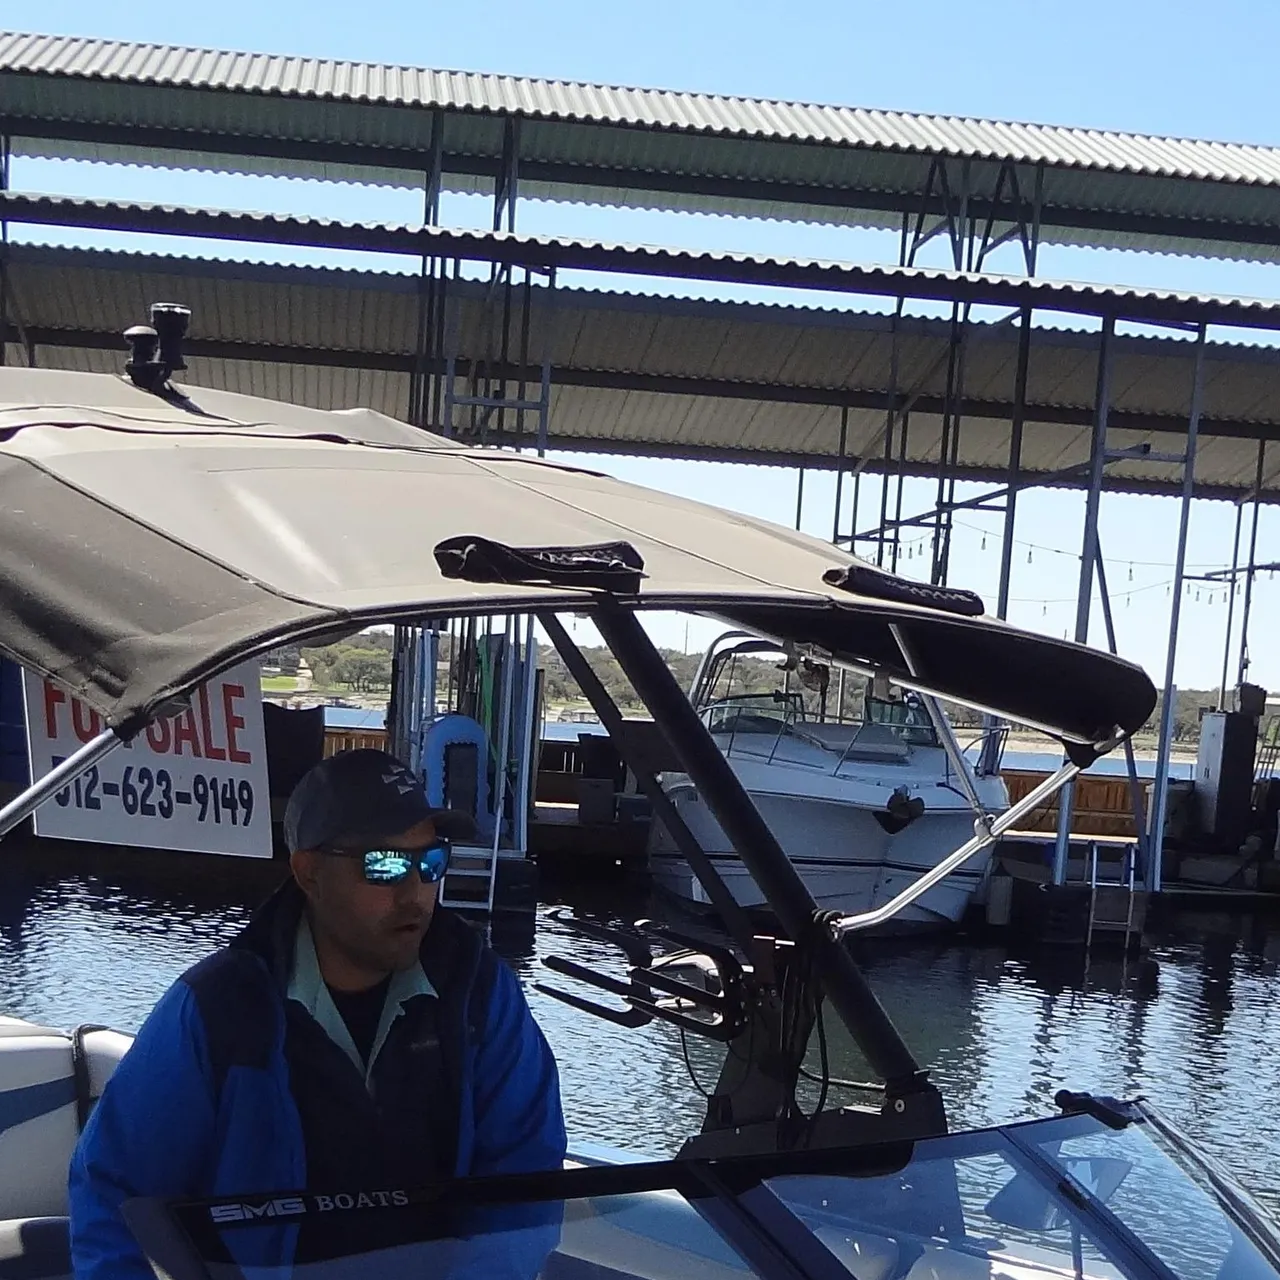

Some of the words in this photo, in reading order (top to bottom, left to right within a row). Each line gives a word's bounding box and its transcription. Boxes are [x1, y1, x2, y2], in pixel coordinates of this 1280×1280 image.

[43, 679, 133, 749] FO
[209, 1197, 307, 1223] SMG
[314, 1190, 409, 1212] BOATS
